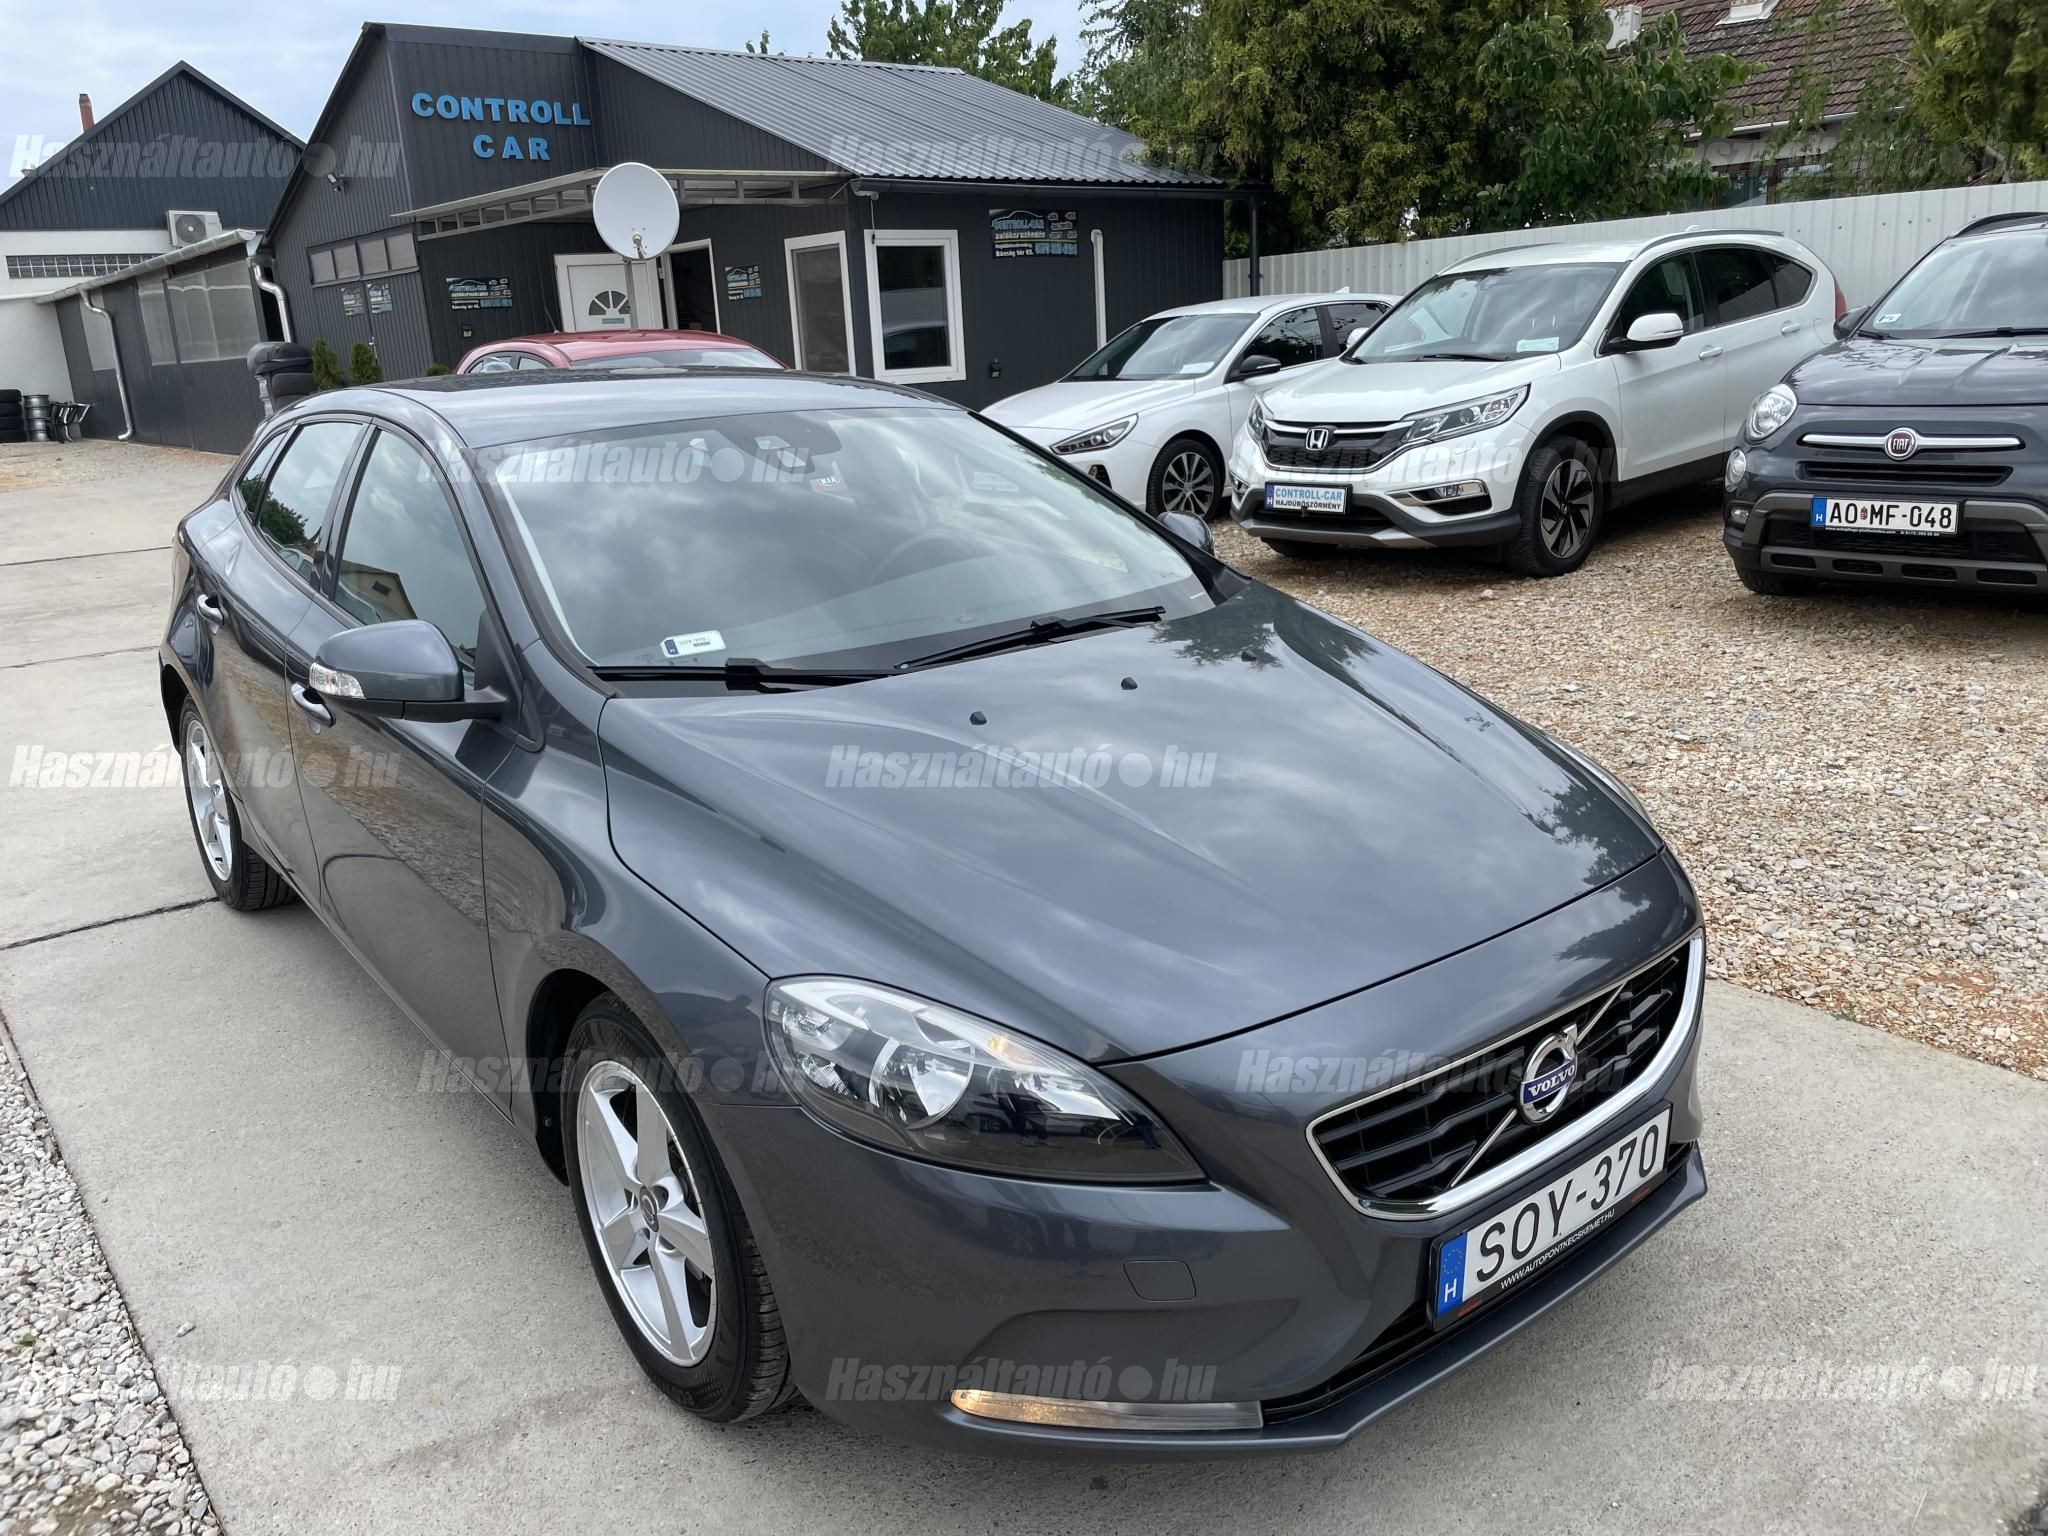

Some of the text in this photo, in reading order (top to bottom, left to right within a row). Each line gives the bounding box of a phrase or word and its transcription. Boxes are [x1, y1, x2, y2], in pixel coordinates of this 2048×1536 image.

[411, 92, 591, 126] CONTROLL
[473, 134, 550, 160] CAR
[1892, 438, 1910, 450] FIAT
[1266, 496, 1273, 505] H
[1275, 488, 1343, 501] CONTROLL-CAR
[1815, 513, 1823, 522] H
[1869, 503, 1952, 529] MF-048
[1528, 1064, 1575, 1097] VOLVO
[1476, 1124, 1659, 1283] SOY-370
[1500, 1208, 1615, 1289] WWW.AUTOPONTKECSKEMET.HU
[1444, 1278, 1457, 1303] H
